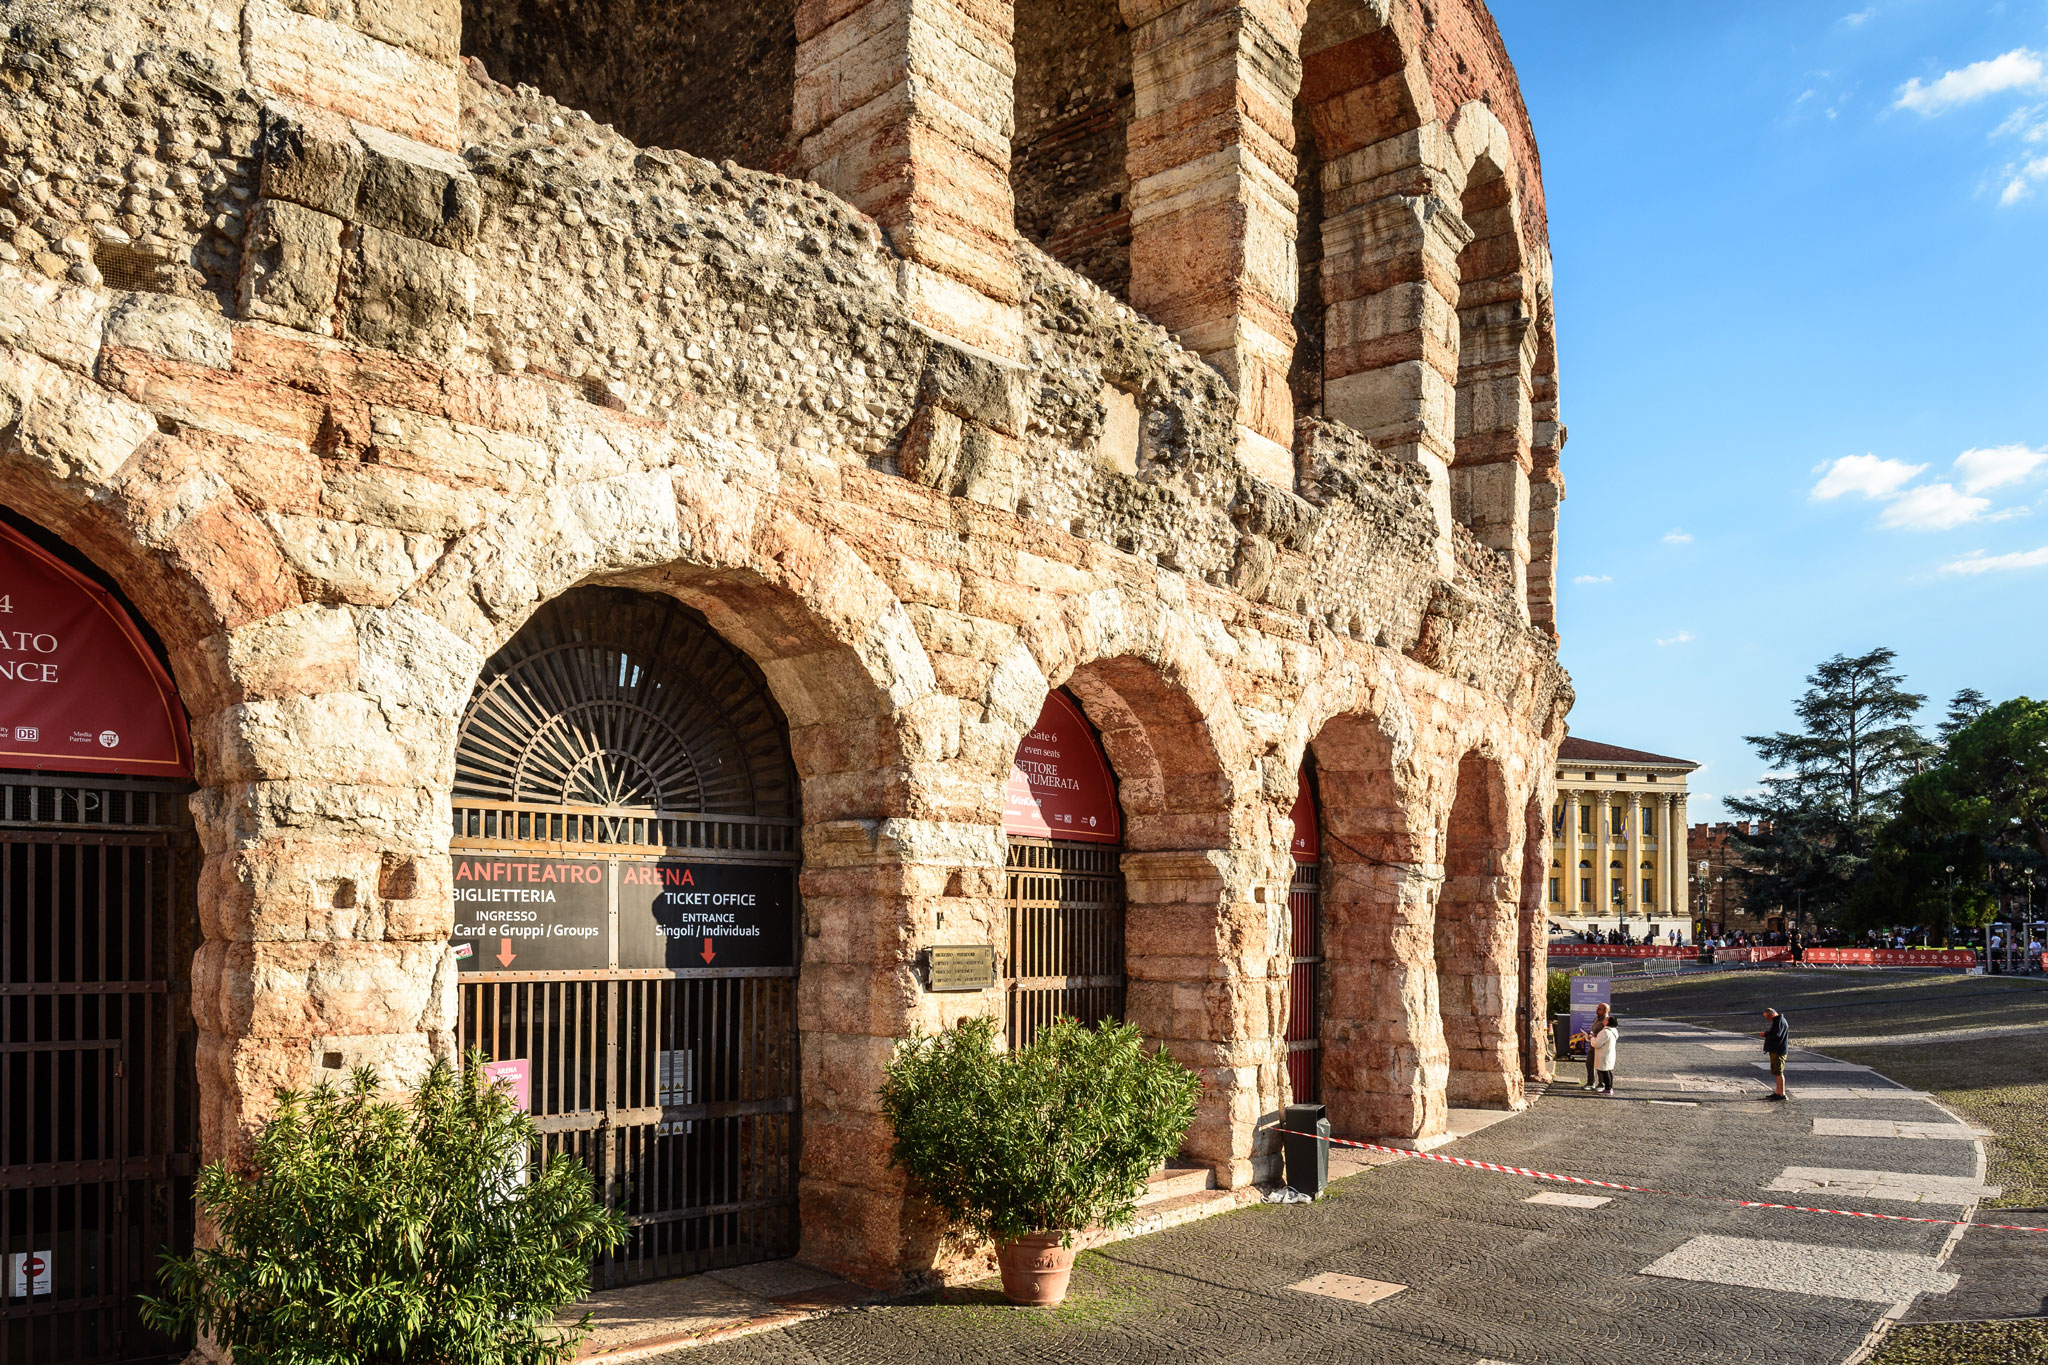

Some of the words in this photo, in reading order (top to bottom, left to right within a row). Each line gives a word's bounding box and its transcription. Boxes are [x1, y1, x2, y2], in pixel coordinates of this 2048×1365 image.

[18, 729, 36, 739] DB
[1028, 729, 1050, 742] Gate
[1051, 733, 1058, 743] 6
[1024, 746, 1042, 755] even
[1043, 749, 1060, 758] seats
[1015, 759, 1058, 776] SETTORE
[1025, 773, 1080, 790] NUMERATA
[455, 861, 602, 884] ANFITEATRO
[623, 866, 695, 886] ARENA
[453, 888, 556, 903] BIGLIETTERIA
[664, 892, 710, 905] TICKET
[712, 893, 756, 906] OFFICE
[476, 911, 537, 922] INGRESSO
[682, 913, 735, 923] ENTRANCE
[454, 923, 486, 937] Card
[489, 926, 497, 937] e
[500, 923, 544, 939] Gruppi
[546, 924, 552, 938] /
[554, 924, 599, 939] Groups
[655, 924, 694, 939] Singoli
[695, 925, 701, 938] /
[702, 925, 760, 937] Individuals
